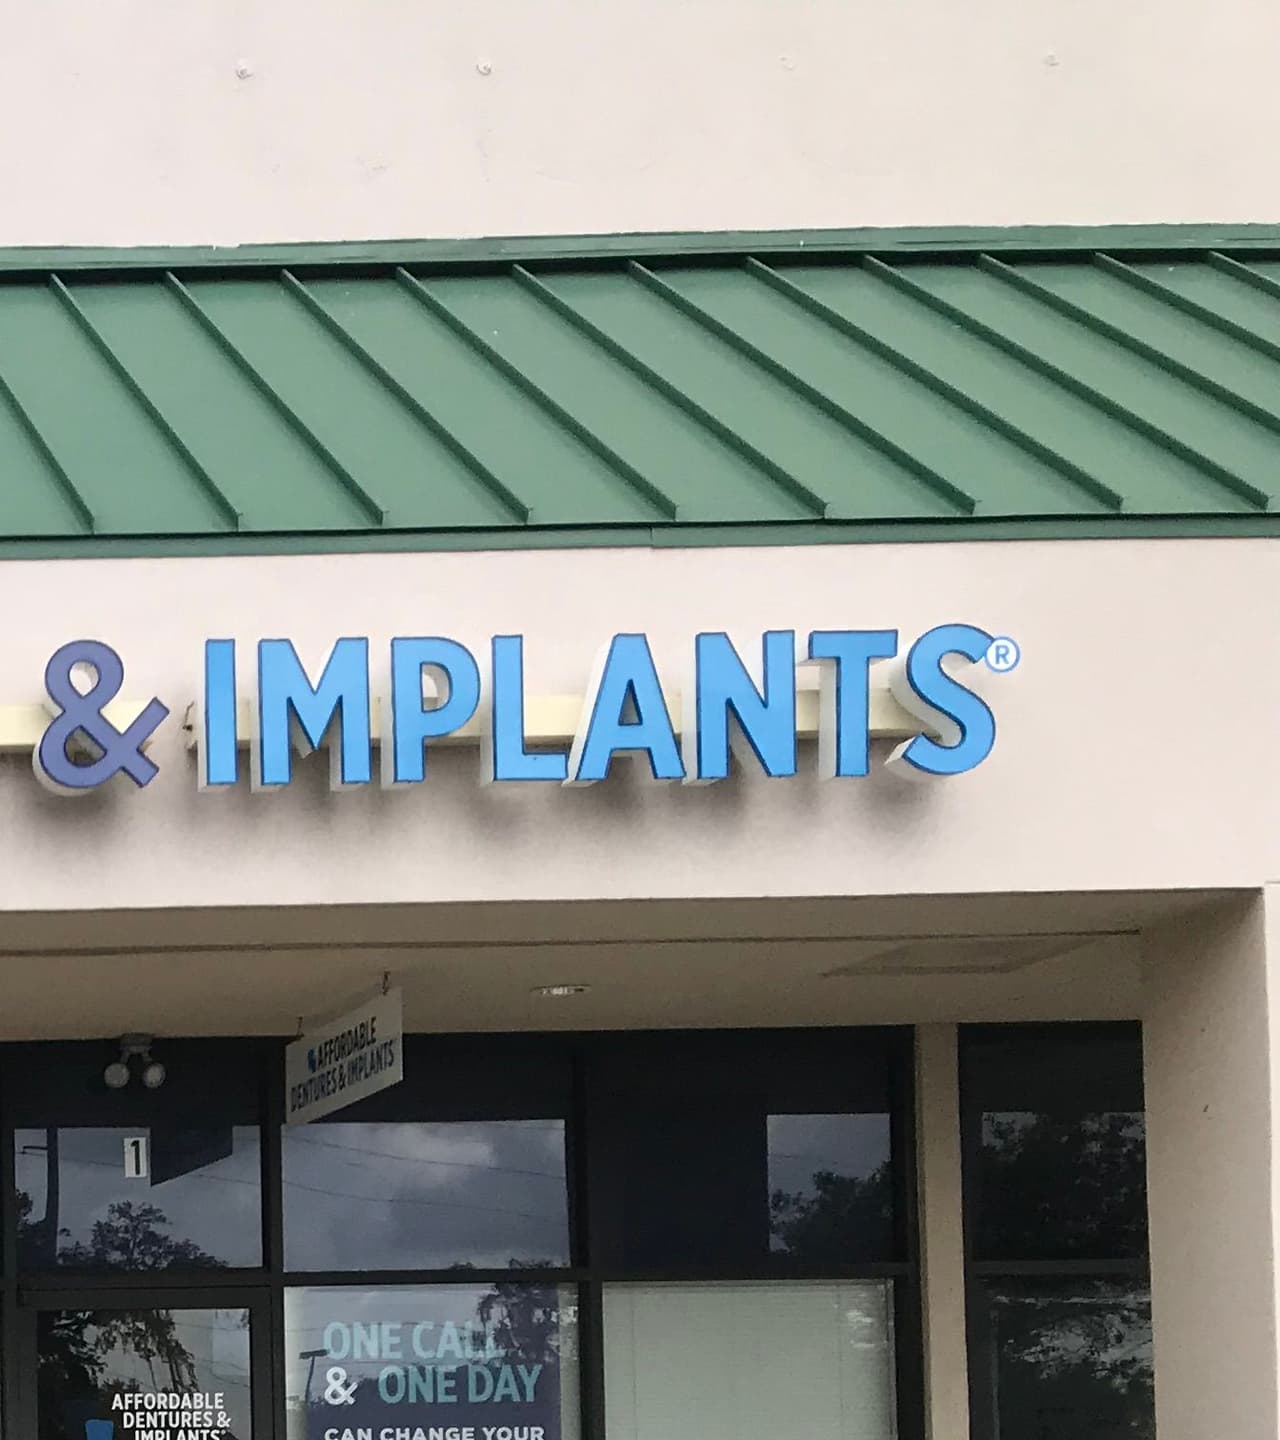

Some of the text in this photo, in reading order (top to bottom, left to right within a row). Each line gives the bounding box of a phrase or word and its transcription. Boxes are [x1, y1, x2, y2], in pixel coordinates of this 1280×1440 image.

[38, 640, 171, 790] &
[317, 1016, 376, 1069] AFFORDABLE
[291, 1040, 394, 1112] DENTURES & IMPLANTS
[130, 1139, 141, 1175] 1
[323, 1319, 506, 1361] ONE CALL
[111, 1392, 225, 1410] AFFORDABLE
[324, 1364, 543, 1406] & ONE DAY
[123, 1411, 231, 1428] DENTURES &
